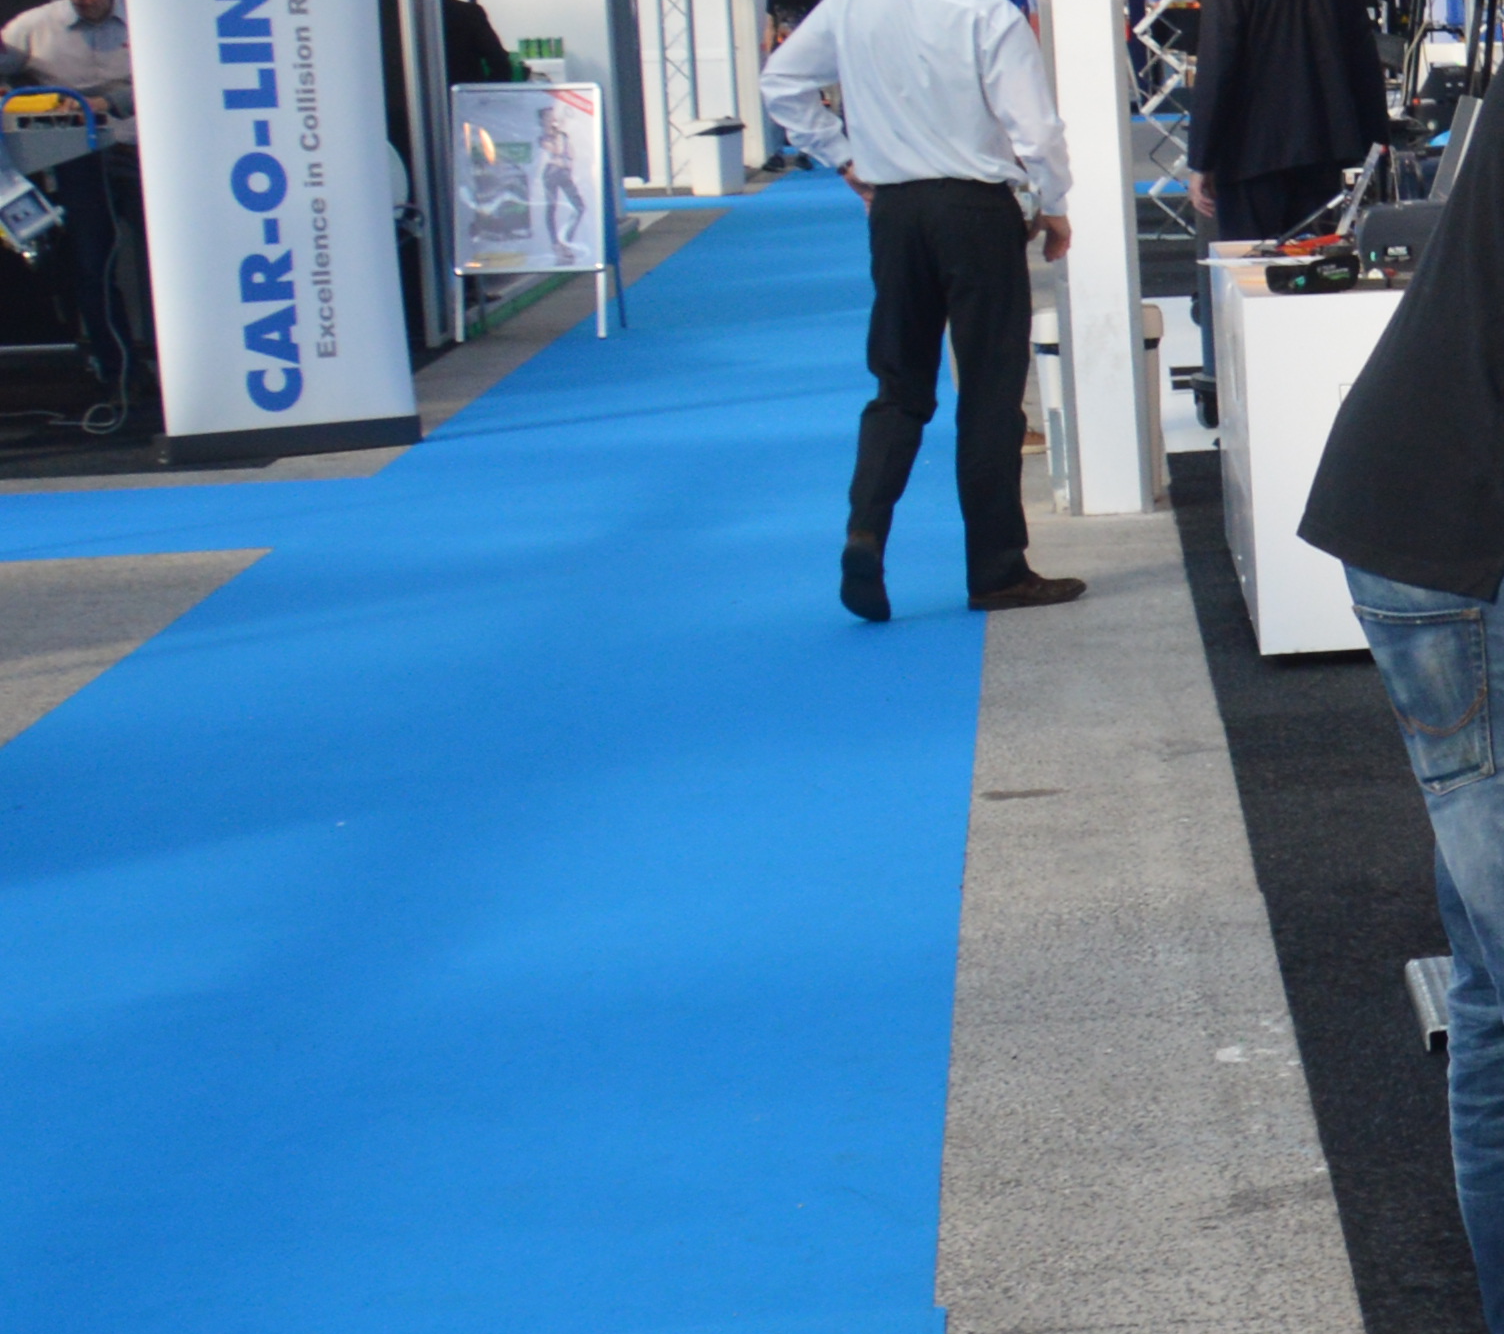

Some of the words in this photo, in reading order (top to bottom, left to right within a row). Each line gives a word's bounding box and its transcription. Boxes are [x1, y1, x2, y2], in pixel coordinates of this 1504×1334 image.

[295, 26, 321, 154] Collision
[302, 160, 326, 189] in
[302, 196, 338, 359] Excellence
